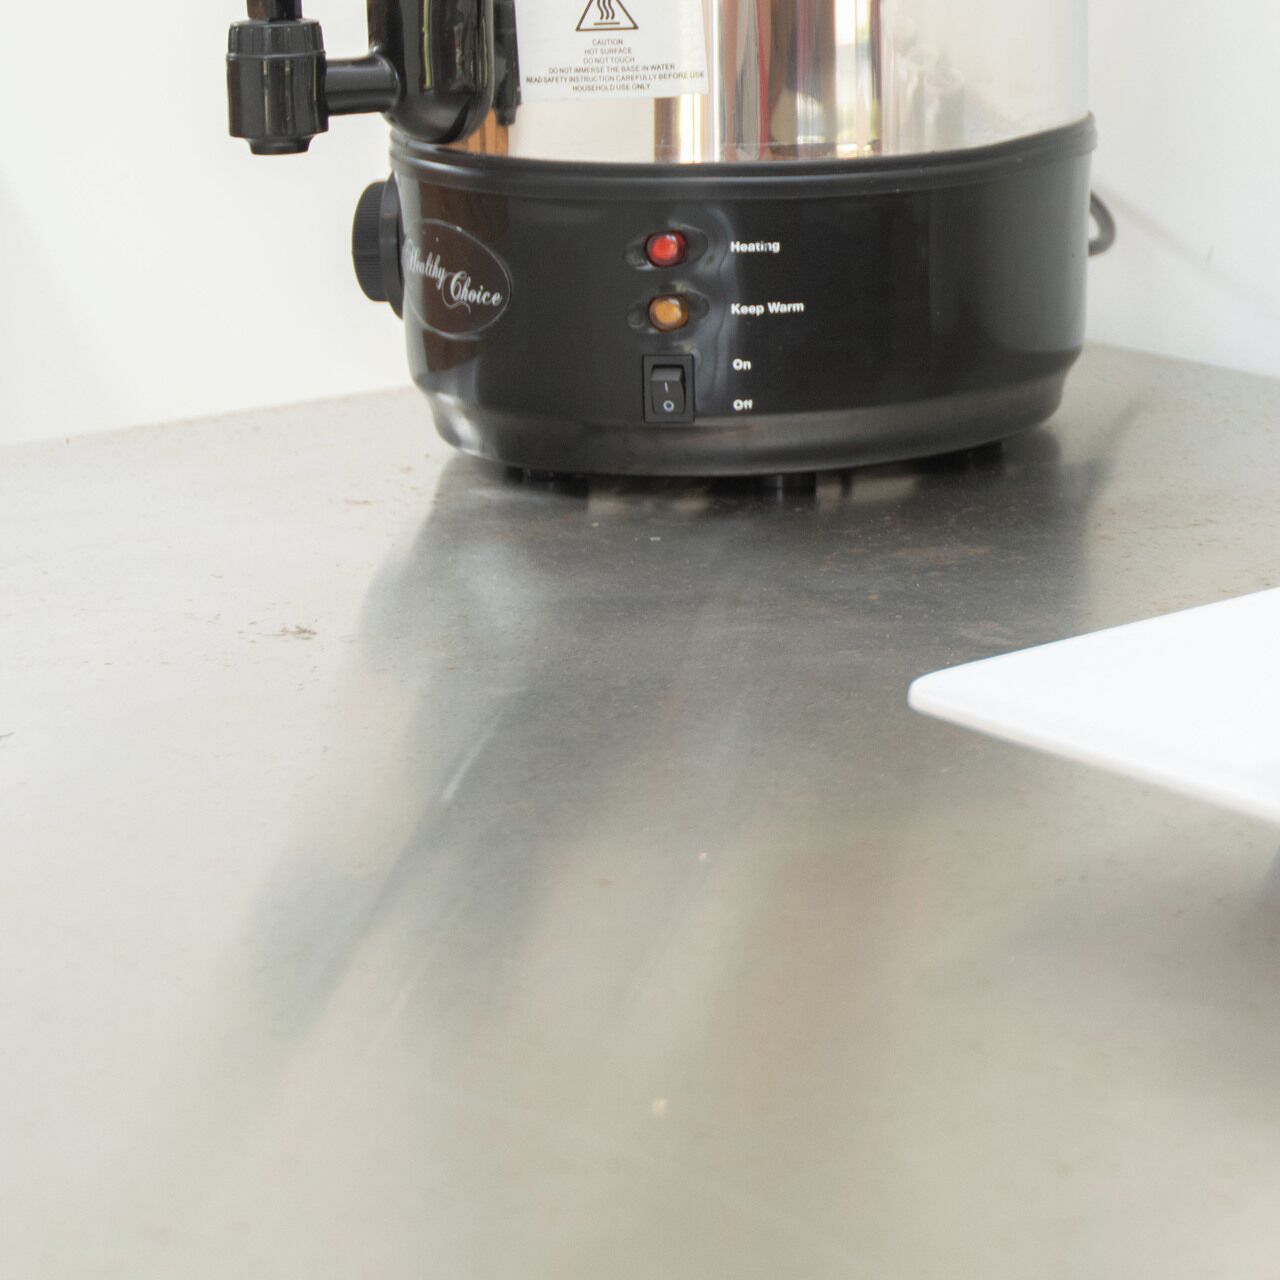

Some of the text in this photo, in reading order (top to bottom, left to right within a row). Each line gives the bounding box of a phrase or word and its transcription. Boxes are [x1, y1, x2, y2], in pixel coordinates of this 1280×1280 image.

[592, 38, 624, 46] CAUTION
[584, 47, 632, 55] HOT SURFACE
[583, 56, 635, 65] DO NOT TOUCH
[574, 66, 605, 74] IMMERSE
[621, 65, 640, 73] BASE
[641, 64, 649, 72] IN
[650, 63, 675, 72] WATER
[526, 75, 542, 84] READ
[543, 75, 567, 84] SAFETY
[568, 74, 614, 83] INSTRUCTION
[658, 71, 688, 80] BEFORE
[572, 83, 651, 92] HOUSEHOLD USE ONLY
[730, 241, 781, 254] Heating
[409, 247, 446, 291] Healthy
[442, 270, 502, 314] Choice
[731, 301, 805, 317] Keep Warm
[732, 358, 752, 371] On
[733, 399, 753, 412] Off
